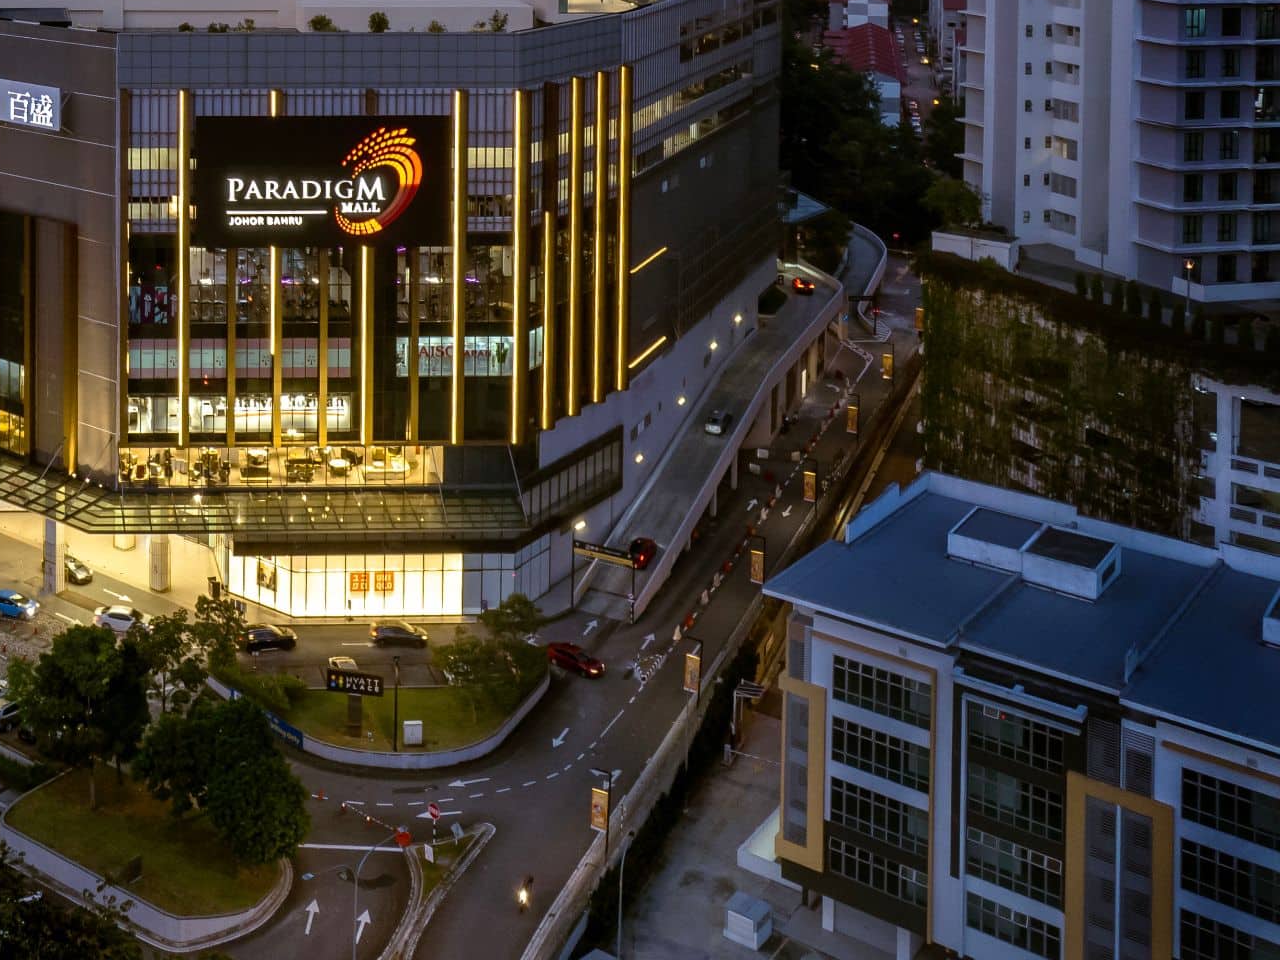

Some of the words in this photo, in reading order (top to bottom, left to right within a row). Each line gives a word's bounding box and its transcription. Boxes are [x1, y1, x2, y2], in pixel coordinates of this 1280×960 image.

[8, 90, 53, 127] 百盛
[226, 176, 387, 202] PARADIGM
[341, 201, 381, 214] MALL
[228, 216, 265, 226] JOHOR
[266, 216, 303, 226] BAHRU
[419, 345, 454, 358] AISO
[345, 676, 380, 687] HYATT
